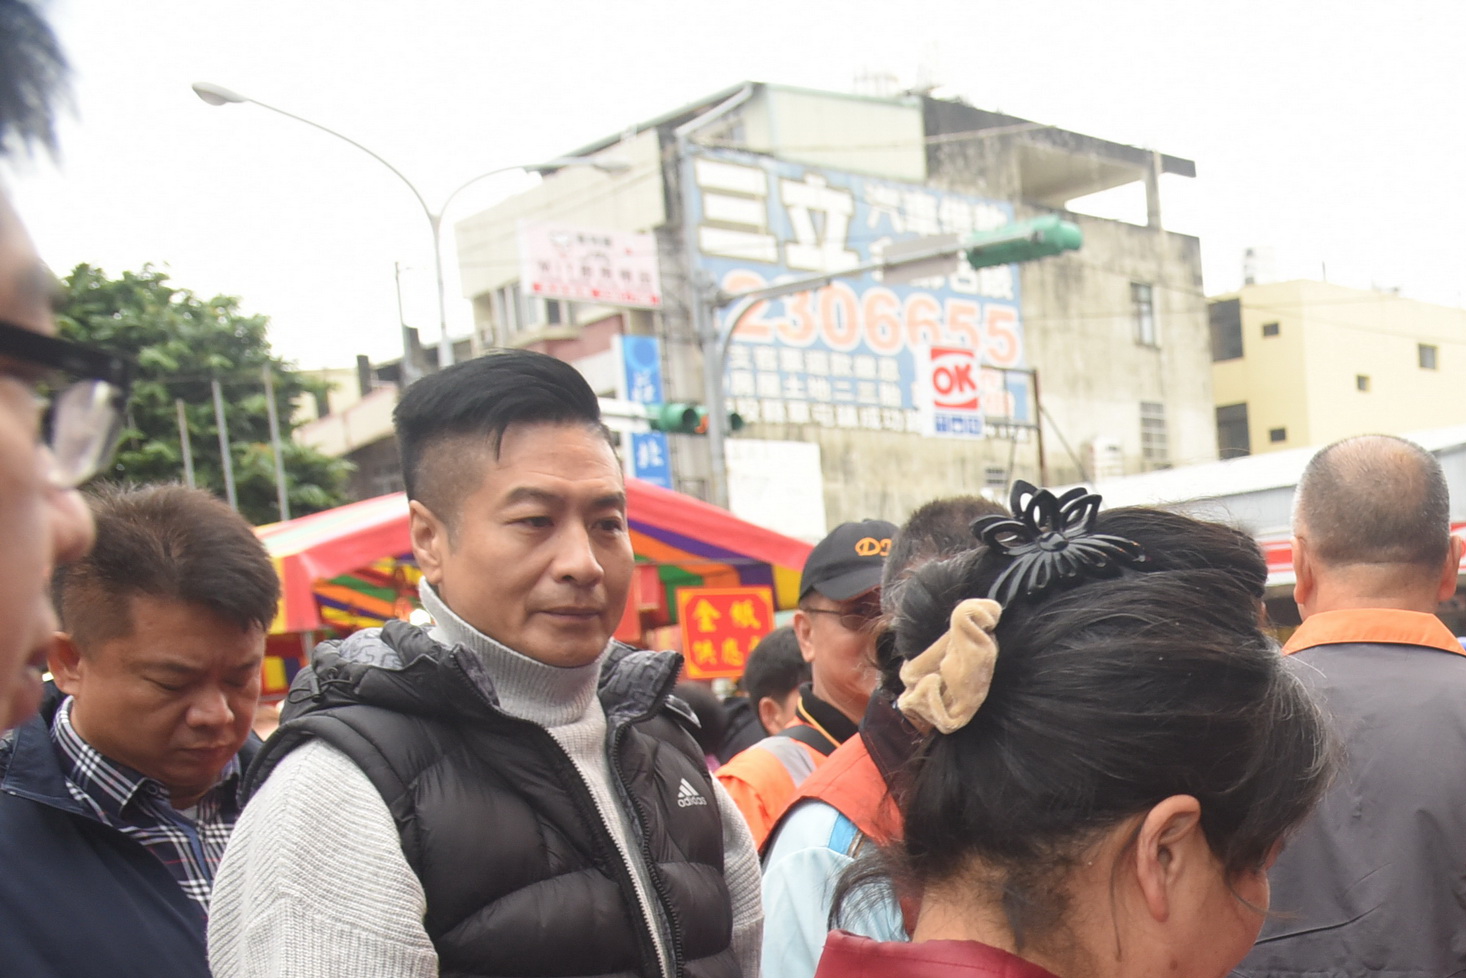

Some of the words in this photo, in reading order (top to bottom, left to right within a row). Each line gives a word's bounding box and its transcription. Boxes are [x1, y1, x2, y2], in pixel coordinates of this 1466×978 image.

[694, 157, 860, 273] 三立
[721, 268, 1025, 366] 2306655
[931, 361, 977, 397] OK
[692, 635, 760, 667] 供應
[678, 796, 707, 807] adidas
